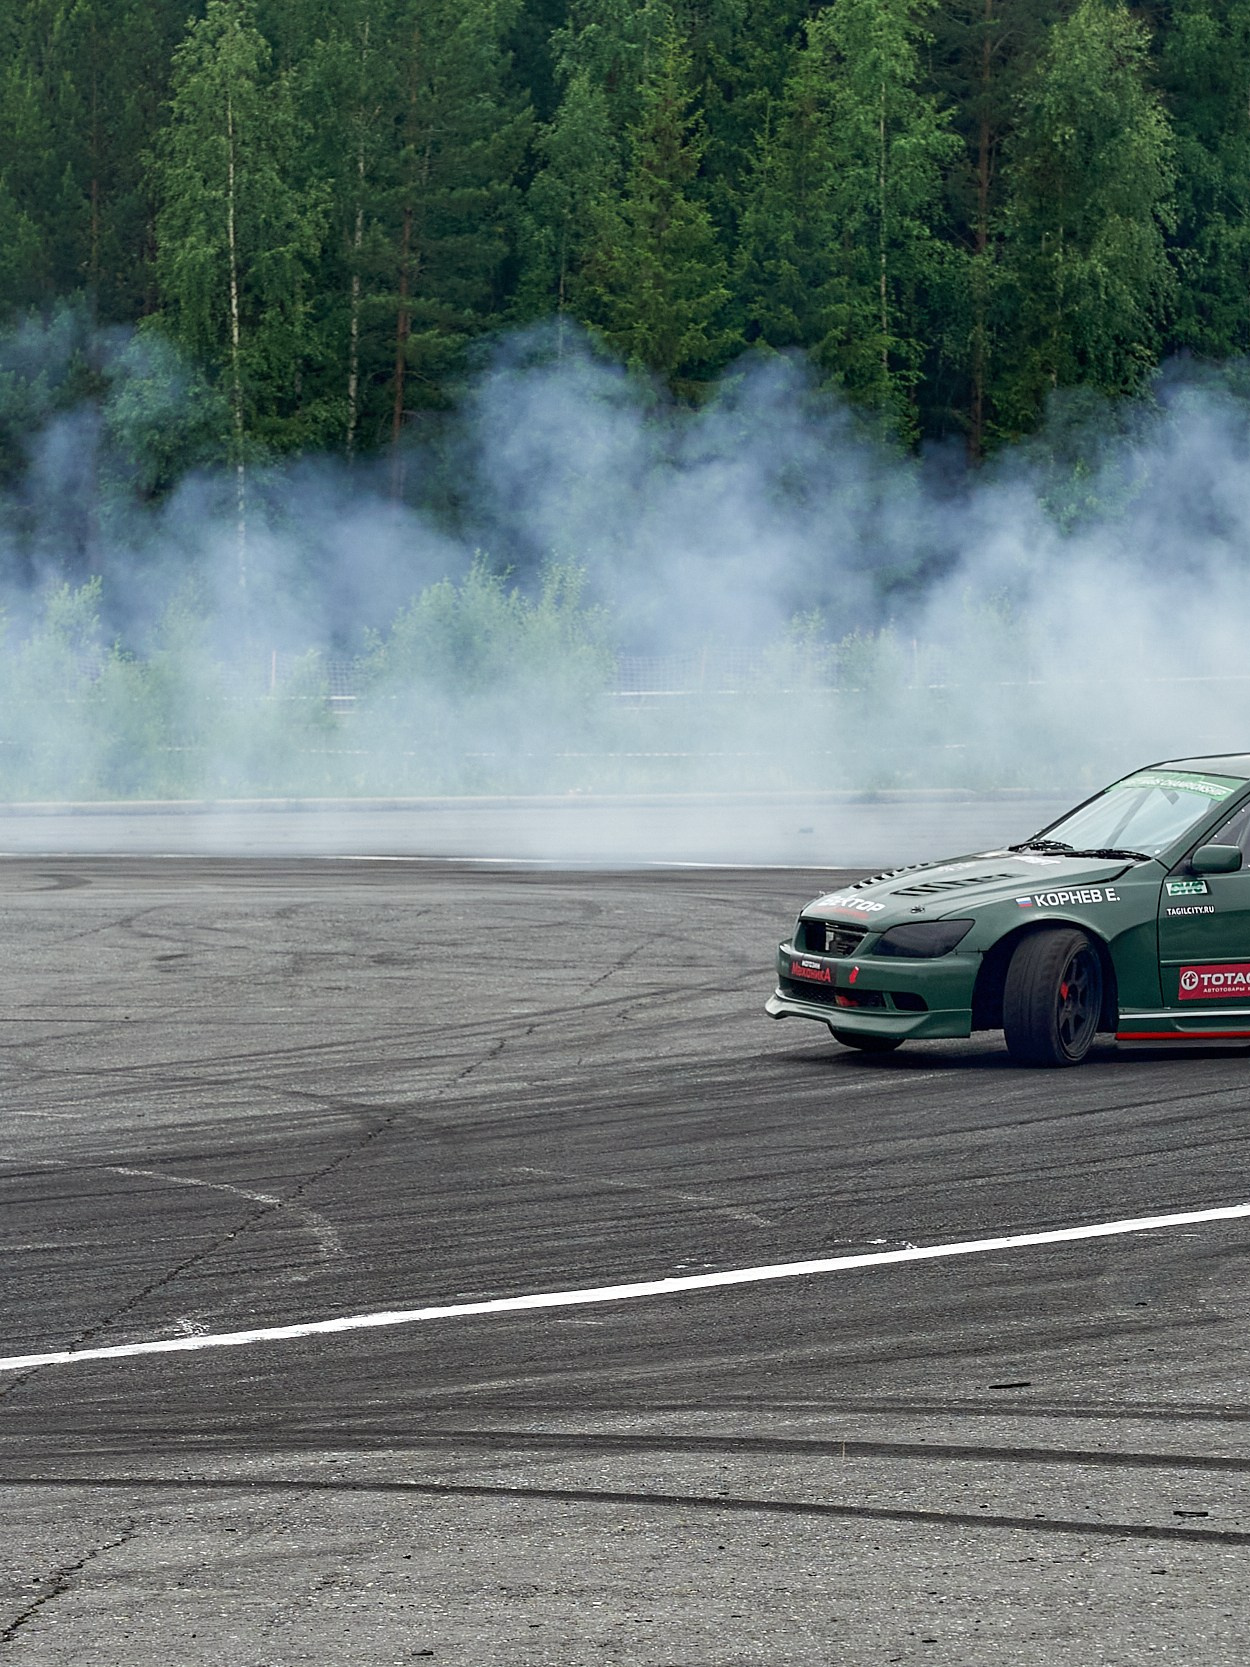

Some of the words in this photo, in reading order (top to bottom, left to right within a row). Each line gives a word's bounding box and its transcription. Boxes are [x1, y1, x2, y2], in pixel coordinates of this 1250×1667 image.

[1034, 889, 1103, 907] КОРНЕВ
[1105, 888, 1120, 902] Е.
[1166, 905, 1215, 916] TAGILCITY.RU
